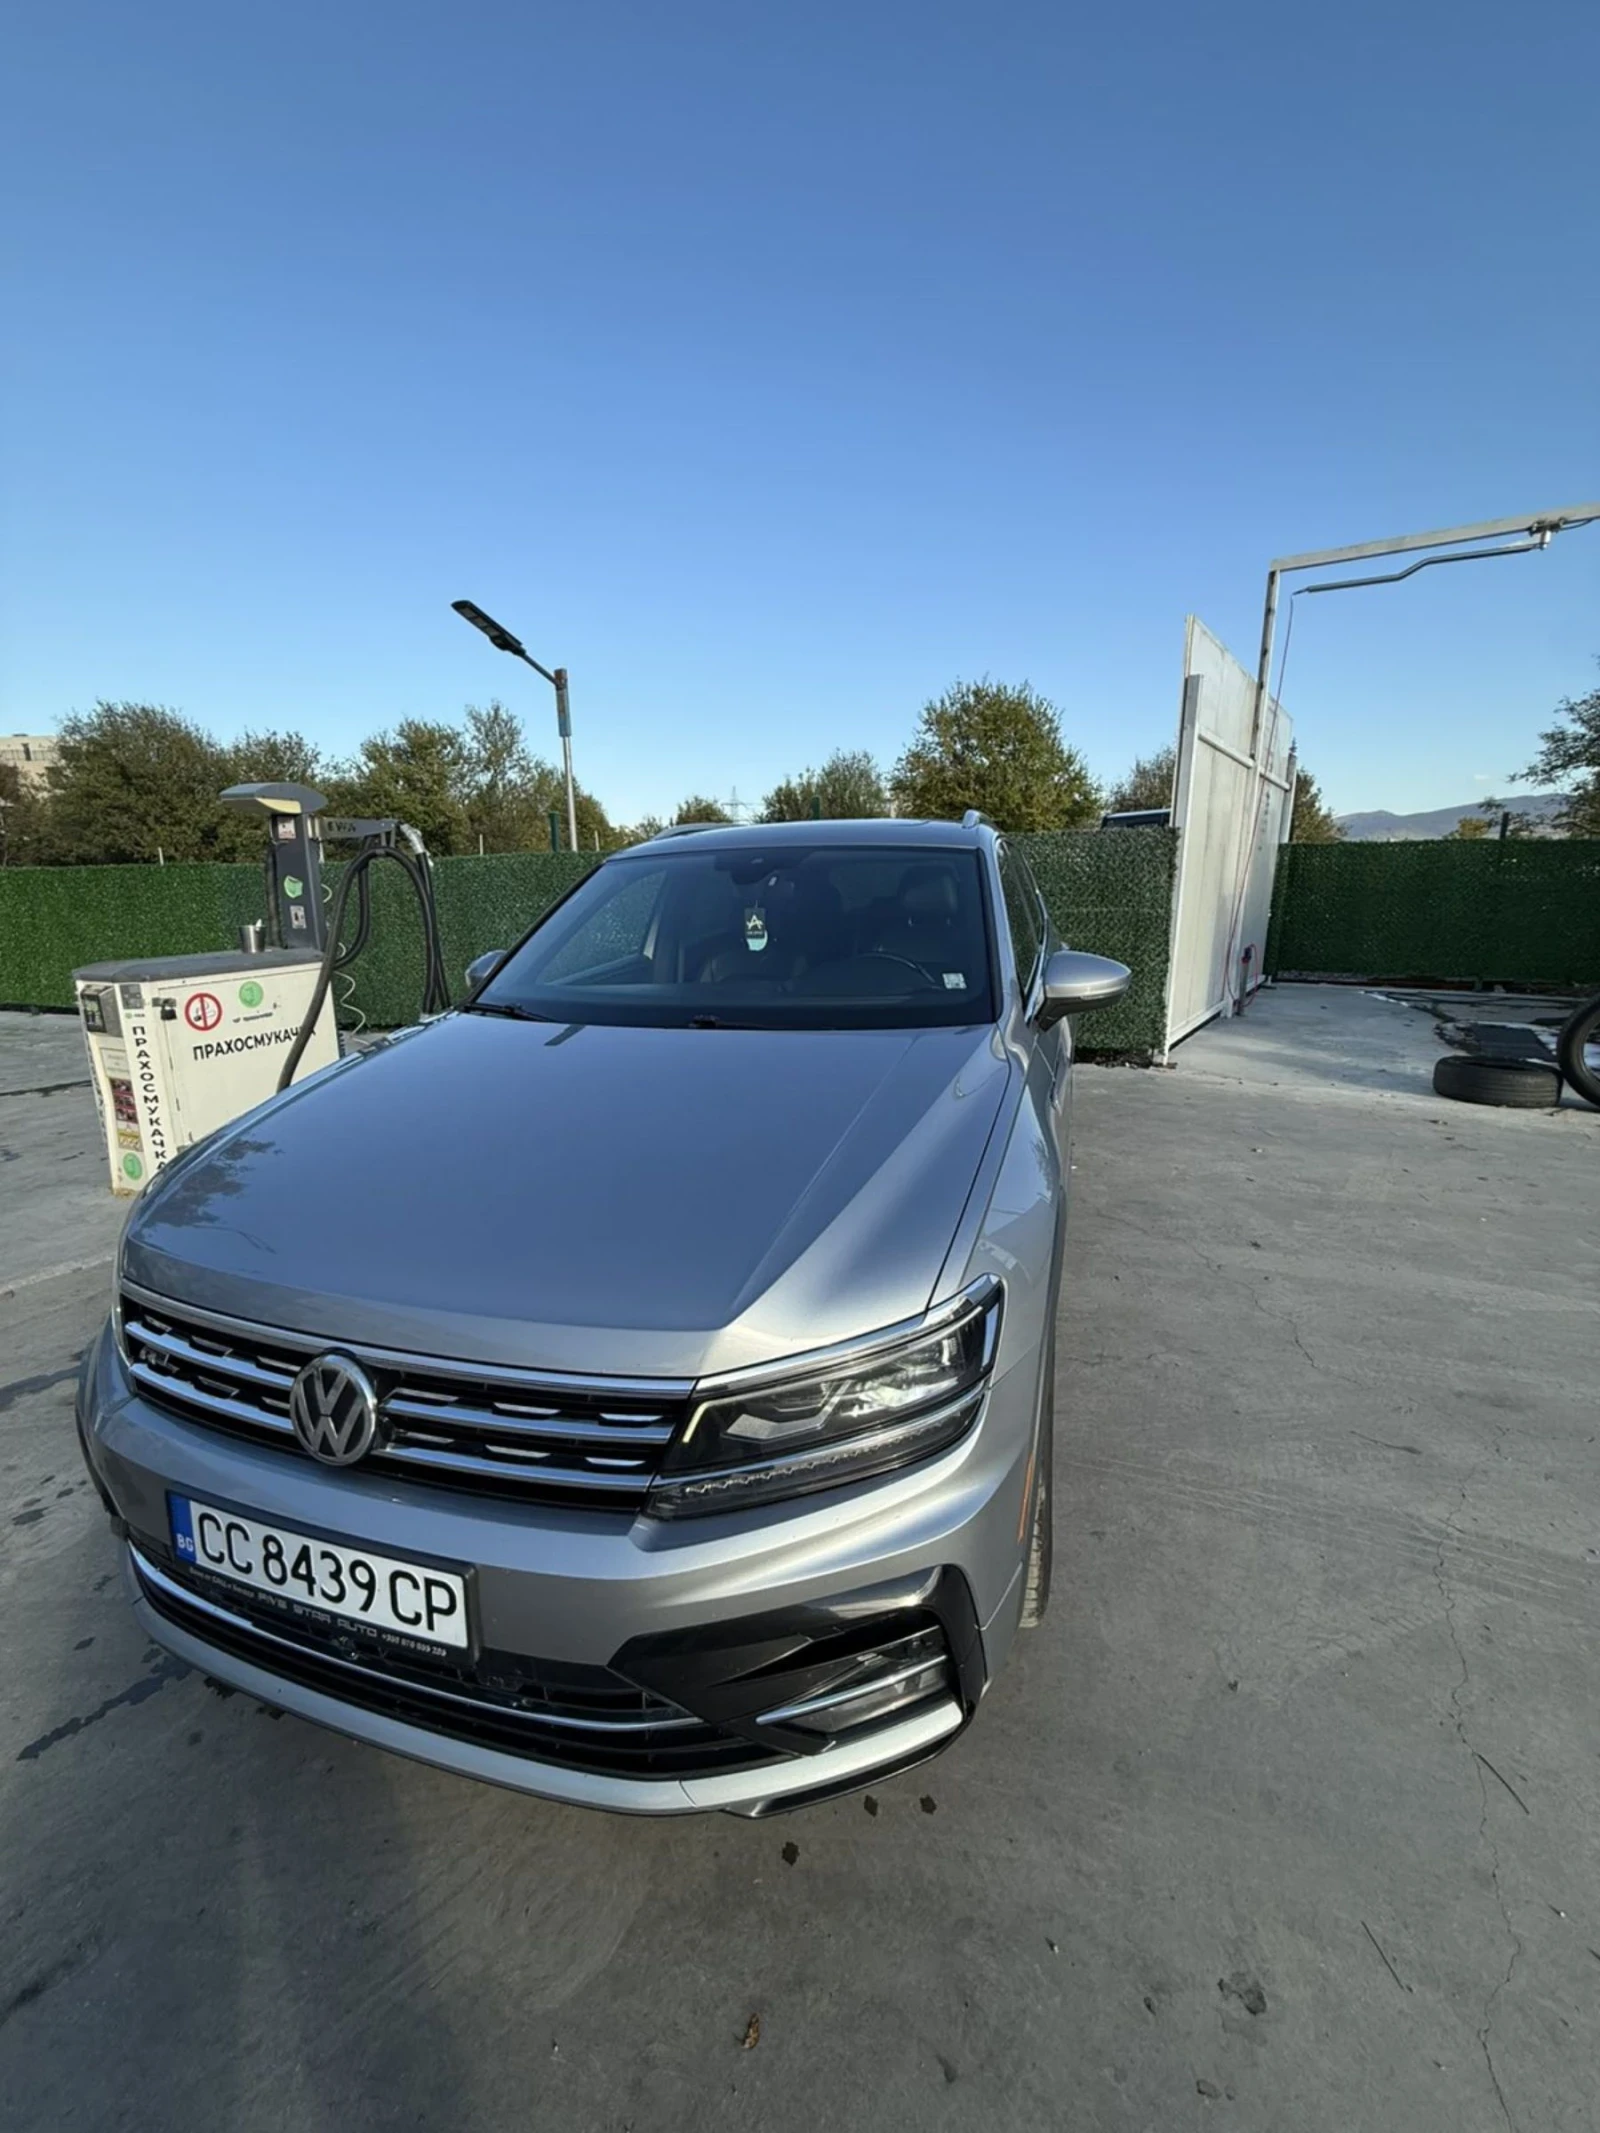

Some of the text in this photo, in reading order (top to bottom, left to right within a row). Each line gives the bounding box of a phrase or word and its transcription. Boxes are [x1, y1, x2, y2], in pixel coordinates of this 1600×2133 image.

[193, 1025, 316, 1061] ПРАХОСМУКАЧ
[176, 1532, 195, 1552] BG
[197, 1511, 253, 1574] CC
[262, 1533, 377, 1613] 8439
[389, 1569, 458, 1632] CP
[337, 1618, 378, 1638] AUTO
